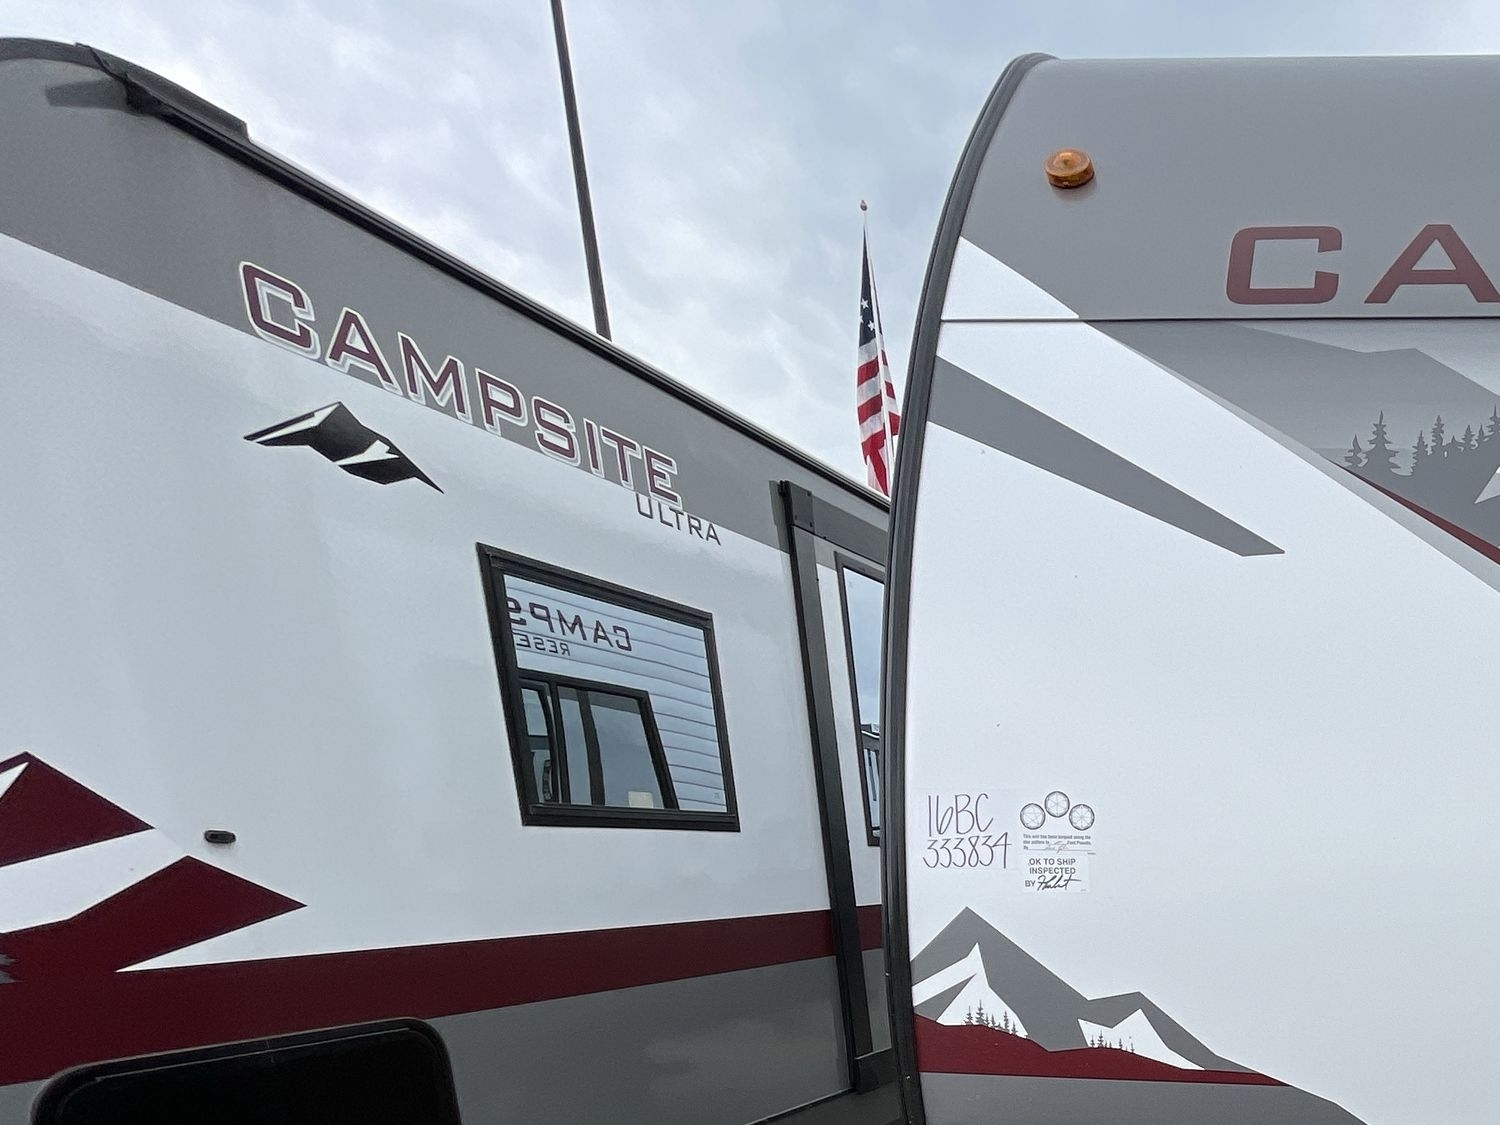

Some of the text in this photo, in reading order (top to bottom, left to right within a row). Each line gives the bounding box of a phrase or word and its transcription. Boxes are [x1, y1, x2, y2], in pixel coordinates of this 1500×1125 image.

[240, 261, 682, 509] CAMPSITE
[636, 493, 722, 546] ULTRA
[928, 793, 994, 837] 16BC
[922, 832, 1012, 869] 333834
[1028, 858, 1076, 866] OK TO SHIP
[1029, 867, 1076, 875] INSPECTED
